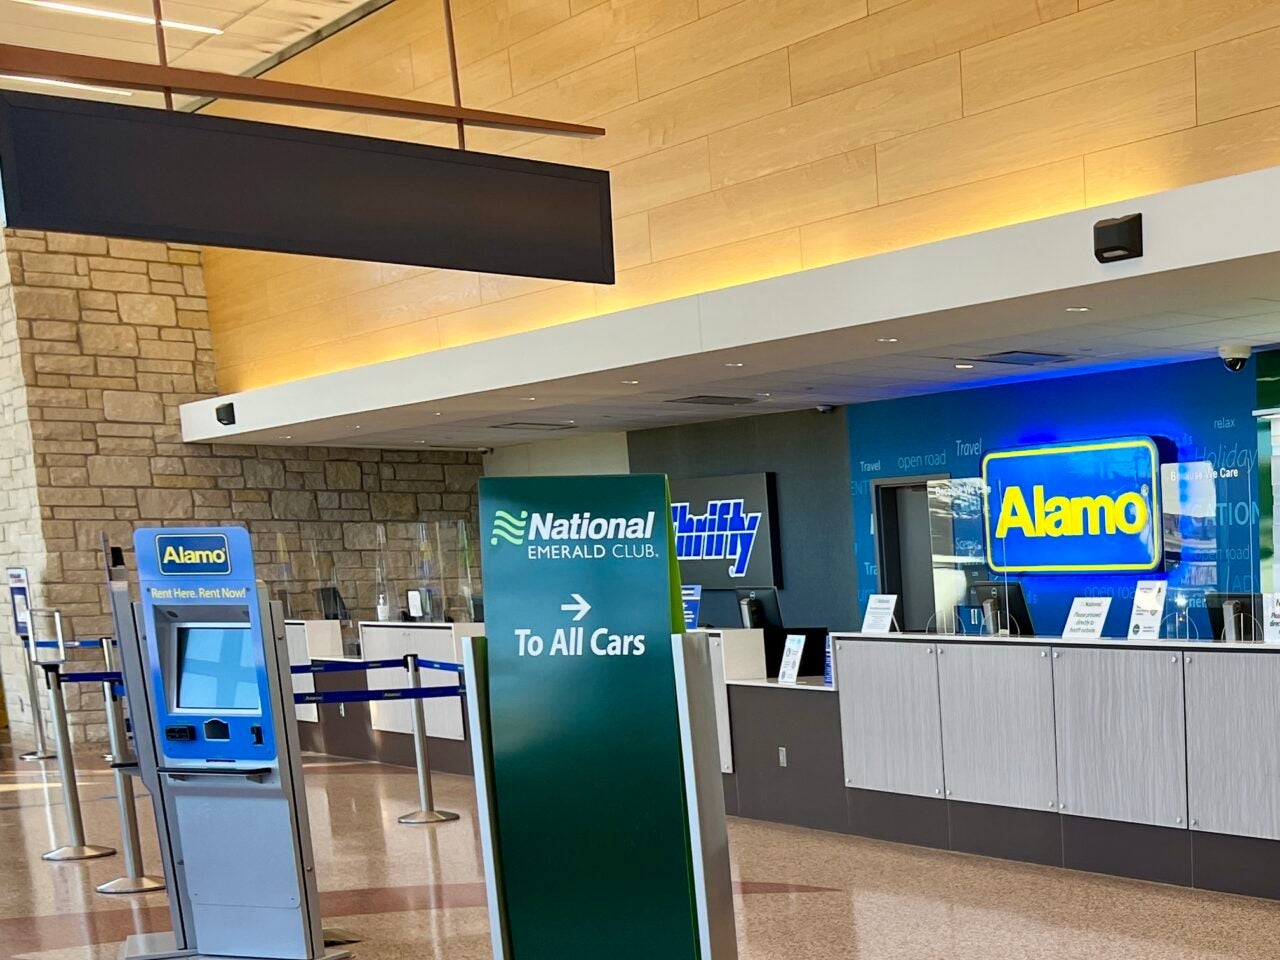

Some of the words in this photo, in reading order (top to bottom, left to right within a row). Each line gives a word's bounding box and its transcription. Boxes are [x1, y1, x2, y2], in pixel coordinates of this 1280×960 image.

[1214, 417, 1235, 429] relax
[955, 438, 982, 456] Travel
[898, 456, 922, 471] open
[925, 453, 947, 467] road
[1195, 442, 1258, 472] Holiday
[860, 460, 881, 473] Travel
[1220, 467, 1239, 478] Care
[995, 485, 1148, 538] Alamo
[528, 511, 656, 541] National
[163, 546, 226, 564] Alamo
[528, 545, 606, 559] EMERALD
[1226, 544, 1249, 560] road
[151, 588, 172, 598] Rent
[174, 588, 197, 598] Here.
[199, 588, 220, 598] Rent
[222, 588, 246, 598] Now!
[514, 628, 544, 656] To
[549, 627, 584, 656] All
[590, 627, 646, 656] Cars
